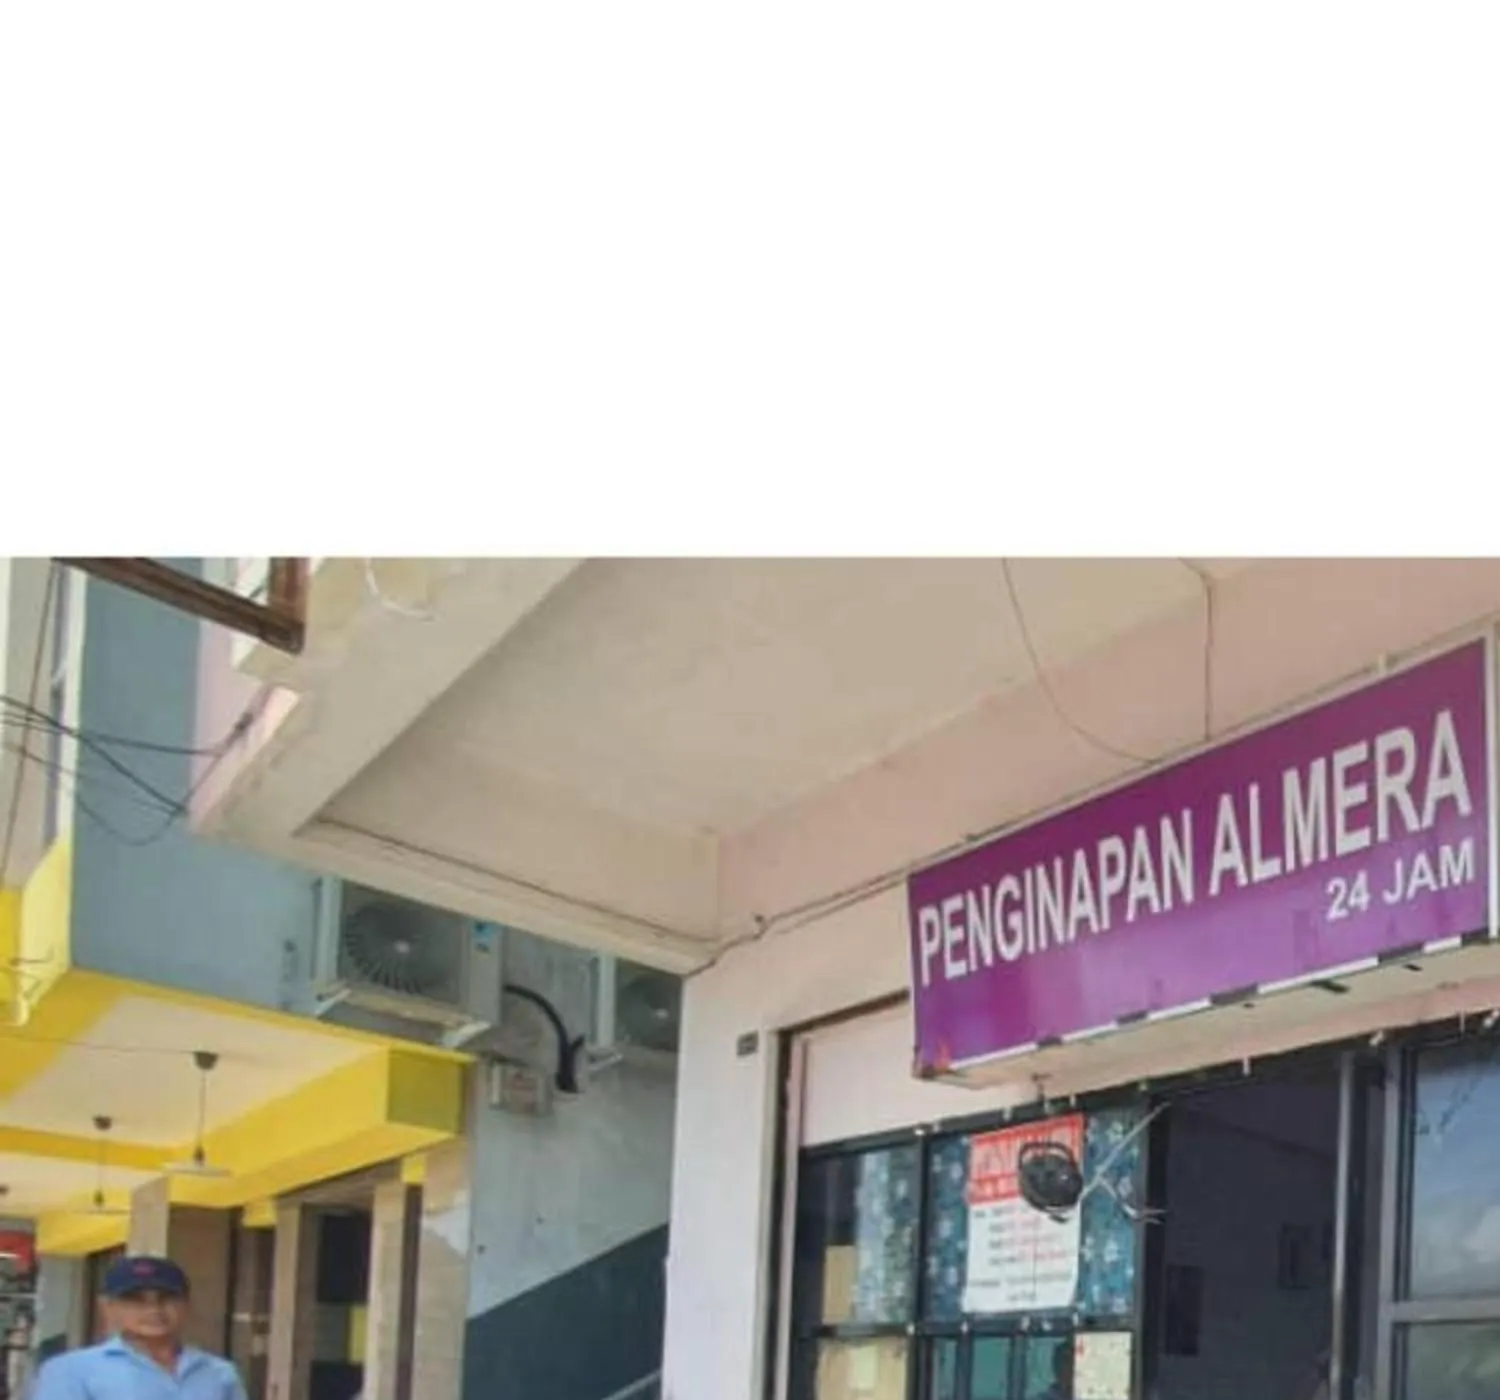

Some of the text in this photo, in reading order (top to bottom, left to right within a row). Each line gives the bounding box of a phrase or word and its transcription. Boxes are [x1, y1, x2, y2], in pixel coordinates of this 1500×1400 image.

[918, 709, 1472, 986] PENGINAPAN ALMERA
[1325, 838, 1474, 921] 24 JAM
